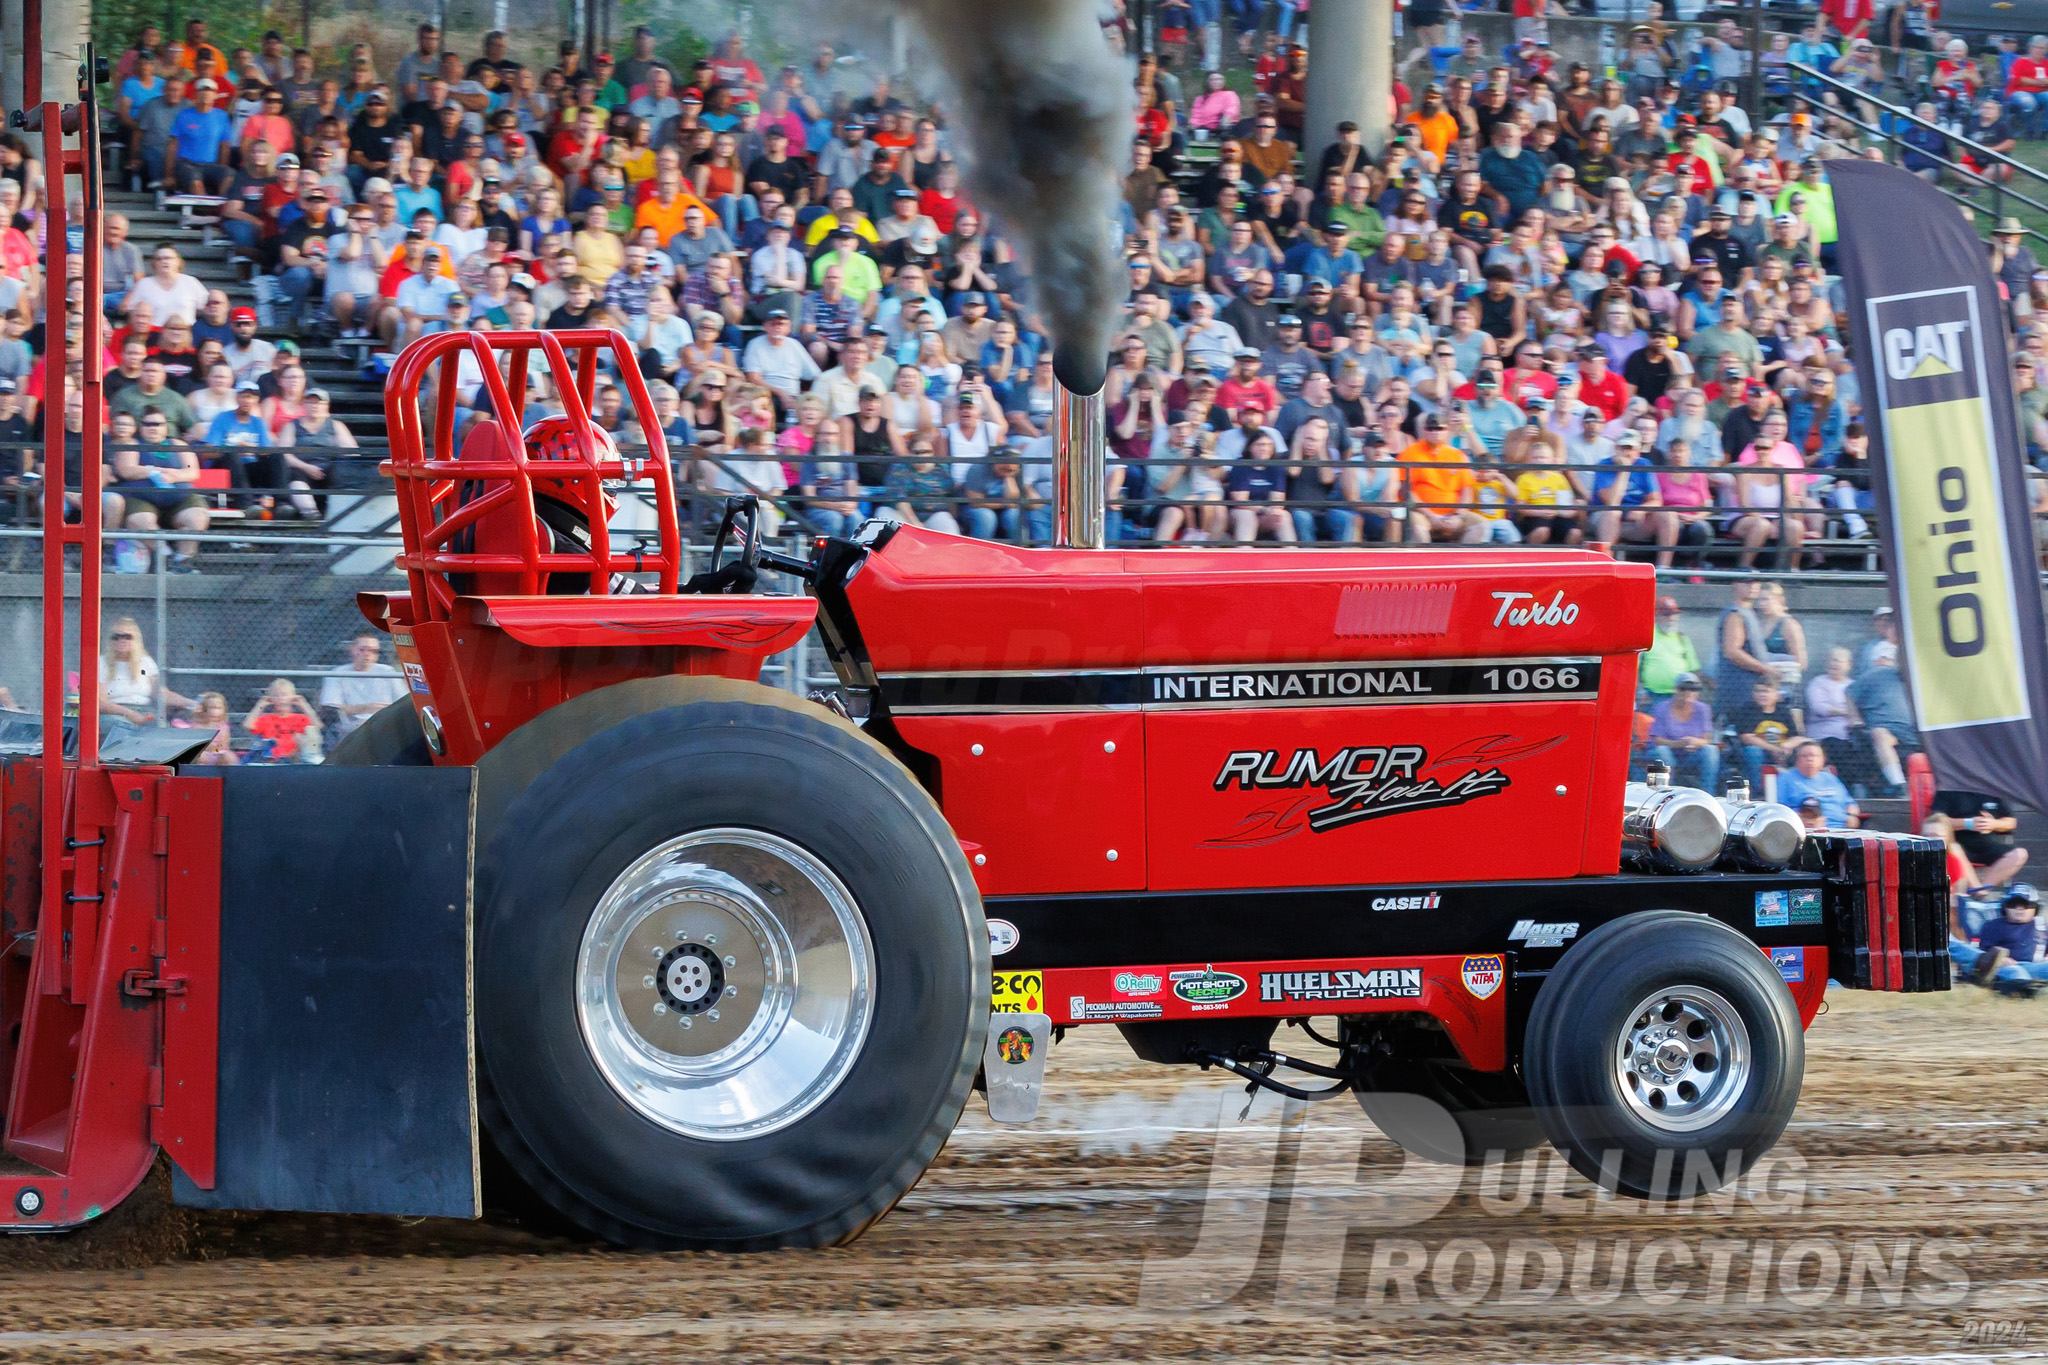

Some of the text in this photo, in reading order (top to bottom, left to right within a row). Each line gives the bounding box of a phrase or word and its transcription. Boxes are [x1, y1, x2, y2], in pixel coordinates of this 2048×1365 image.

[1884, 320, 1970, 380] CAT
[1928, 466, 1985, 658] Ohio
[1491, 590, 1579, 627] Turbo
[1153, 667, 1580, 700] INTERNATIONAL 1066
[1214, 746, 1424, 786] RUMOR
[1508, 919, 1580, 941] HARTS
[1116, 974, 1160, 991] O'Reilly
[1187, 987, 1233, 997] SECRET
[1260, 969, 1421, 1000] HUELSMAN
[1288, 988, 1420, 1000] TRUCKING
[1471, 972, 1495, 985] NTPA
